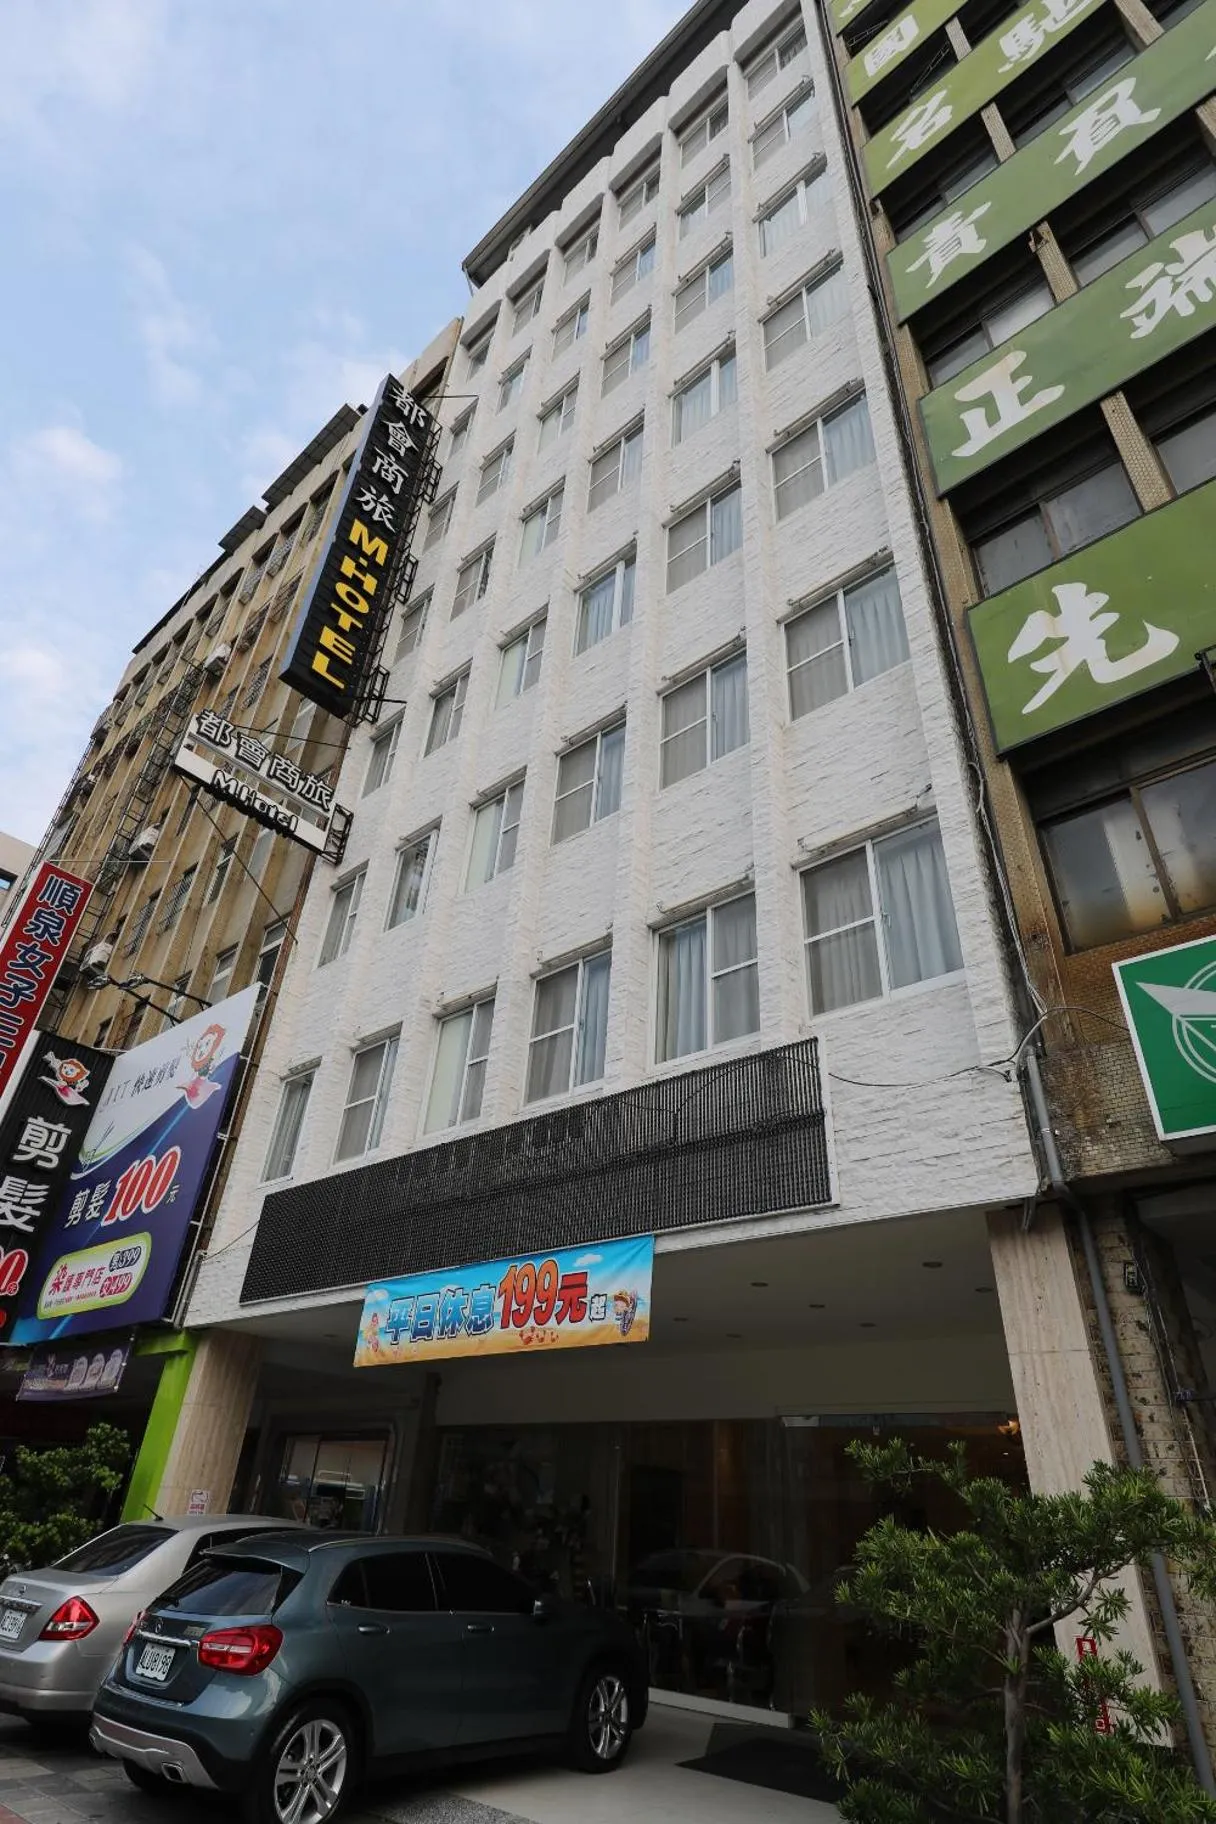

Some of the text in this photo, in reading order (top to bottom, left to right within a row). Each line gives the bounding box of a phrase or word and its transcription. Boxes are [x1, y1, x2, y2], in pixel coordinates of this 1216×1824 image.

[356, 386, 427, 533] 都會商旅
[1007, 582, 1180, 714] 先
[198, 709, 334, 811] 都會商旅
[0, 1116, 72, 1233] 剪髮
[385, 1258, 607, 1346] 平日休息199元起
